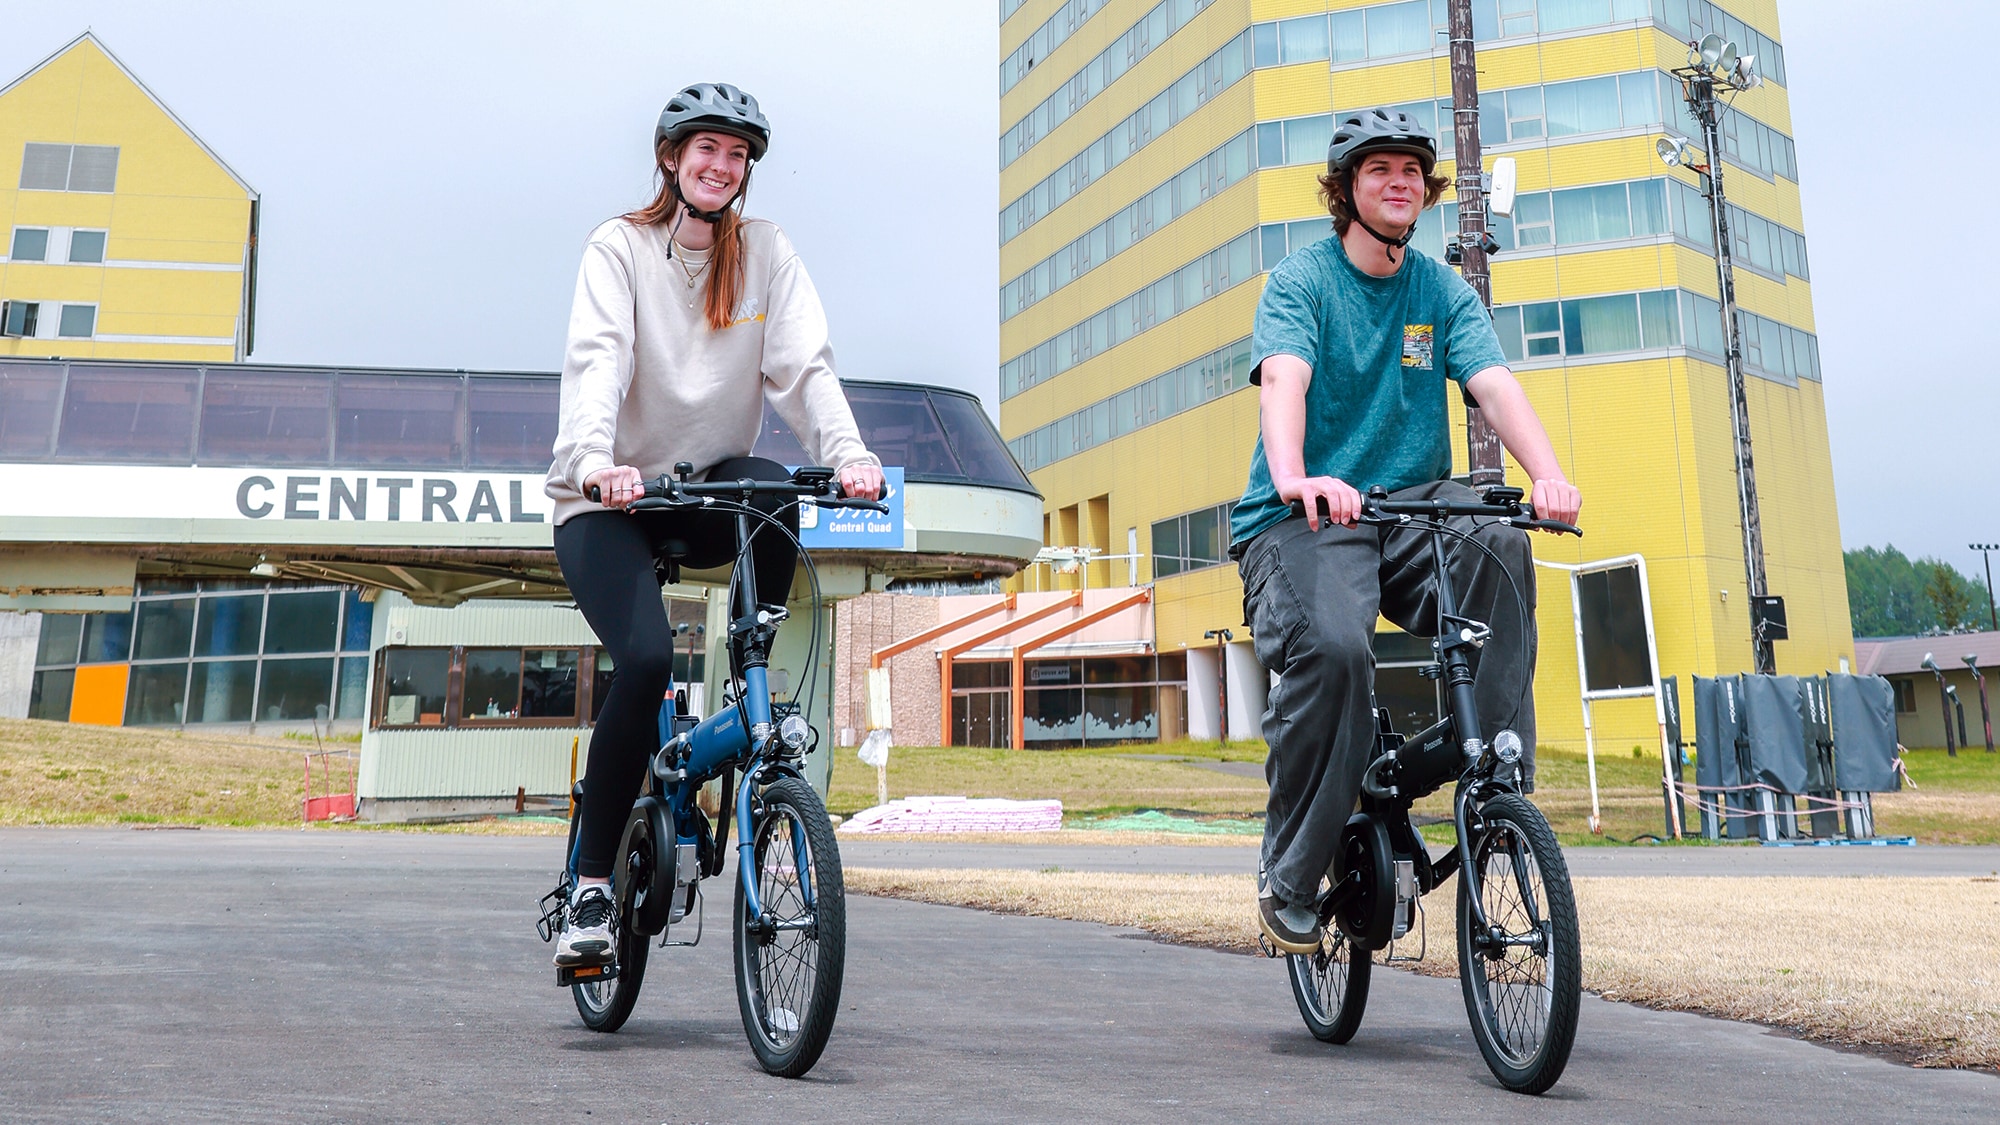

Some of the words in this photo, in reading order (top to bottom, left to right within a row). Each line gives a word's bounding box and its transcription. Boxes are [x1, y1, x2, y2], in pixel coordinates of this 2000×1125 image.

[236, 475, 545, 523] CENTRAL
[829, 522, 865, 533] Central
[867, 522, 892, 533] Quad
